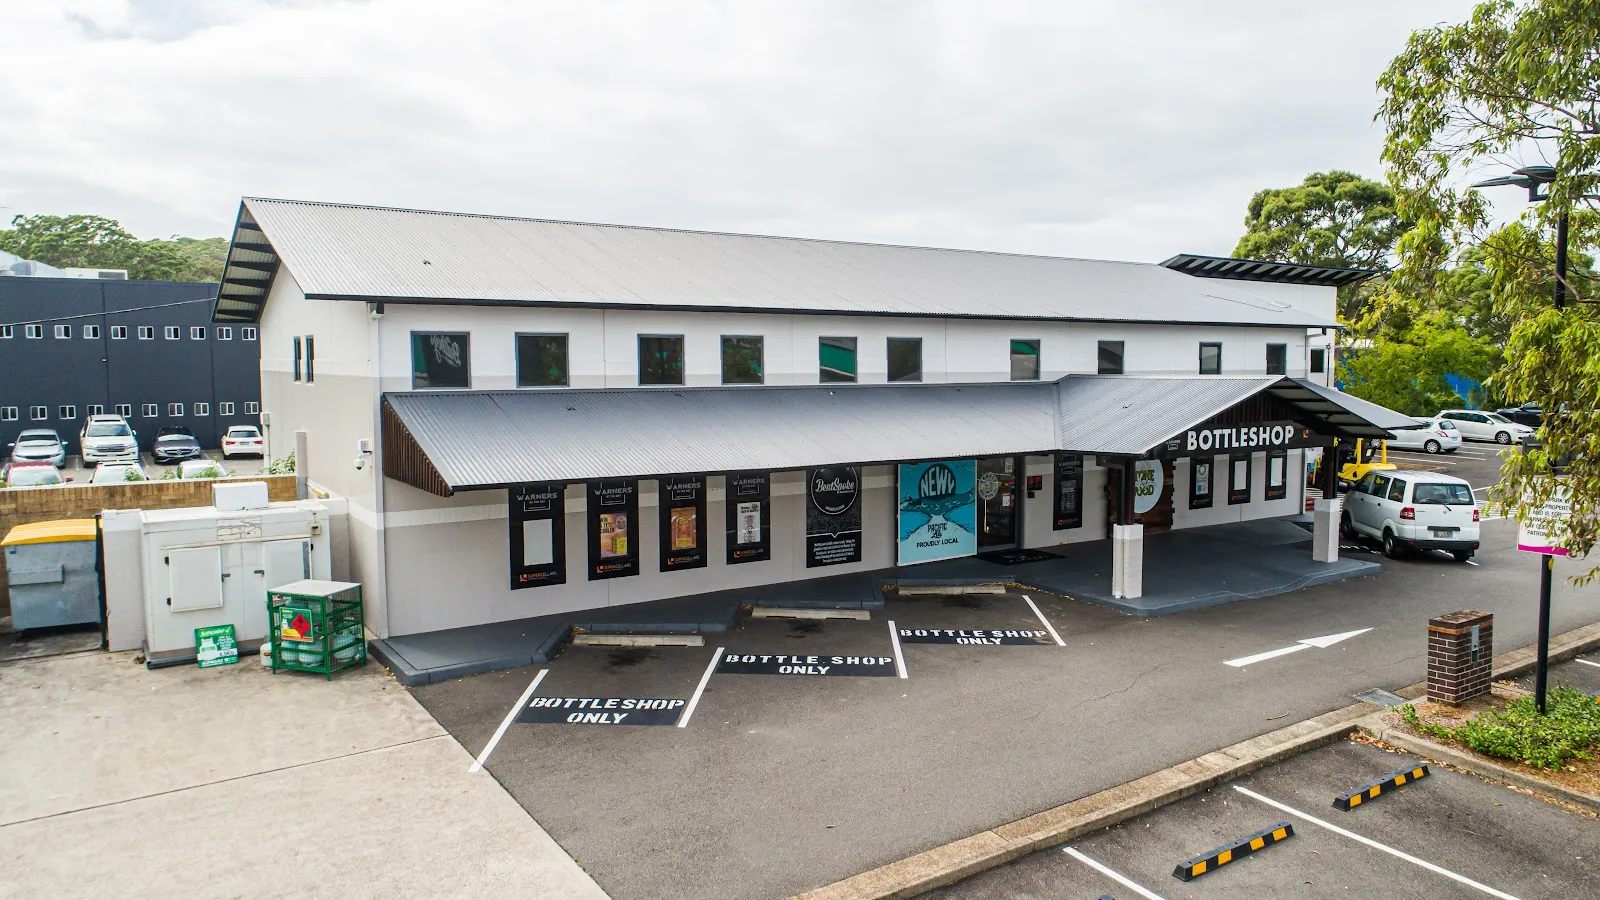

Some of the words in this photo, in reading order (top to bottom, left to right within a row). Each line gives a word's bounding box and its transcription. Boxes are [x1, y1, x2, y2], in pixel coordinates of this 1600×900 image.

[1186, 426, 1294, 450] BOTTLESHOP
[920, 466, 955, 498] NEWY
[594, 486, 632, 495] WARNERS
[516, 492, 558, 500] WARNERS
[928, 522, 948, 532] PACIFIC
[916, 540, 940, 548] PROUDLY
[726, 655, 818, 664] BOTTLE
[831, 656, 892, 665] SHOP
[778, 666, 830, 674] ONLY
[566, 712, 628, 724] ONLY
